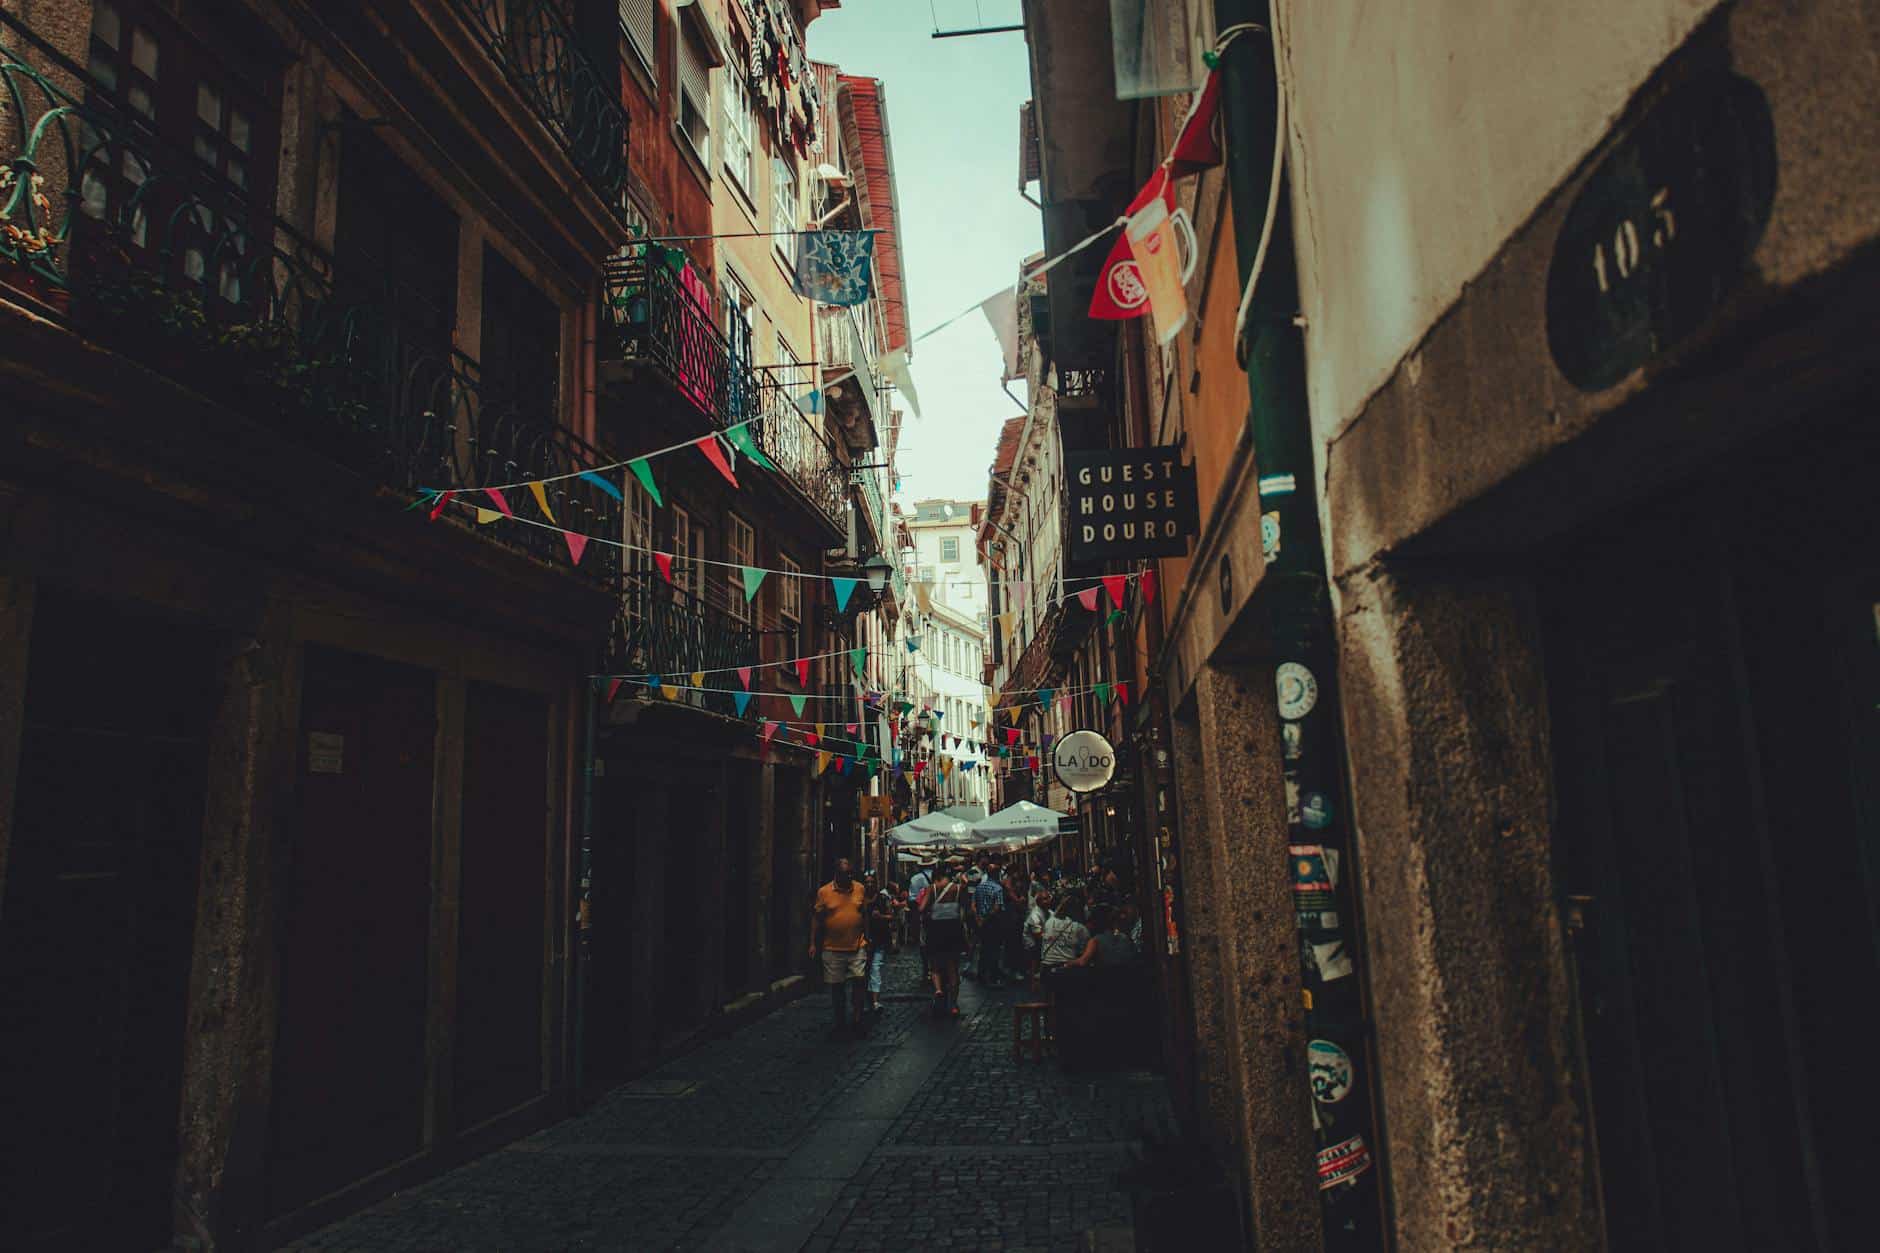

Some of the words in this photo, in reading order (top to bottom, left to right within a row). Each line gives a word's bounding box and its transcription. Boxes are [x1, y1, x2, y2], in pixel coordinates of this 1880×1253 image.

[1079, 461, 1173, 485] GUEST
[1081, 490, 1175, 514] HOUSE
[1082, 520, 1177, 543] DOURO
